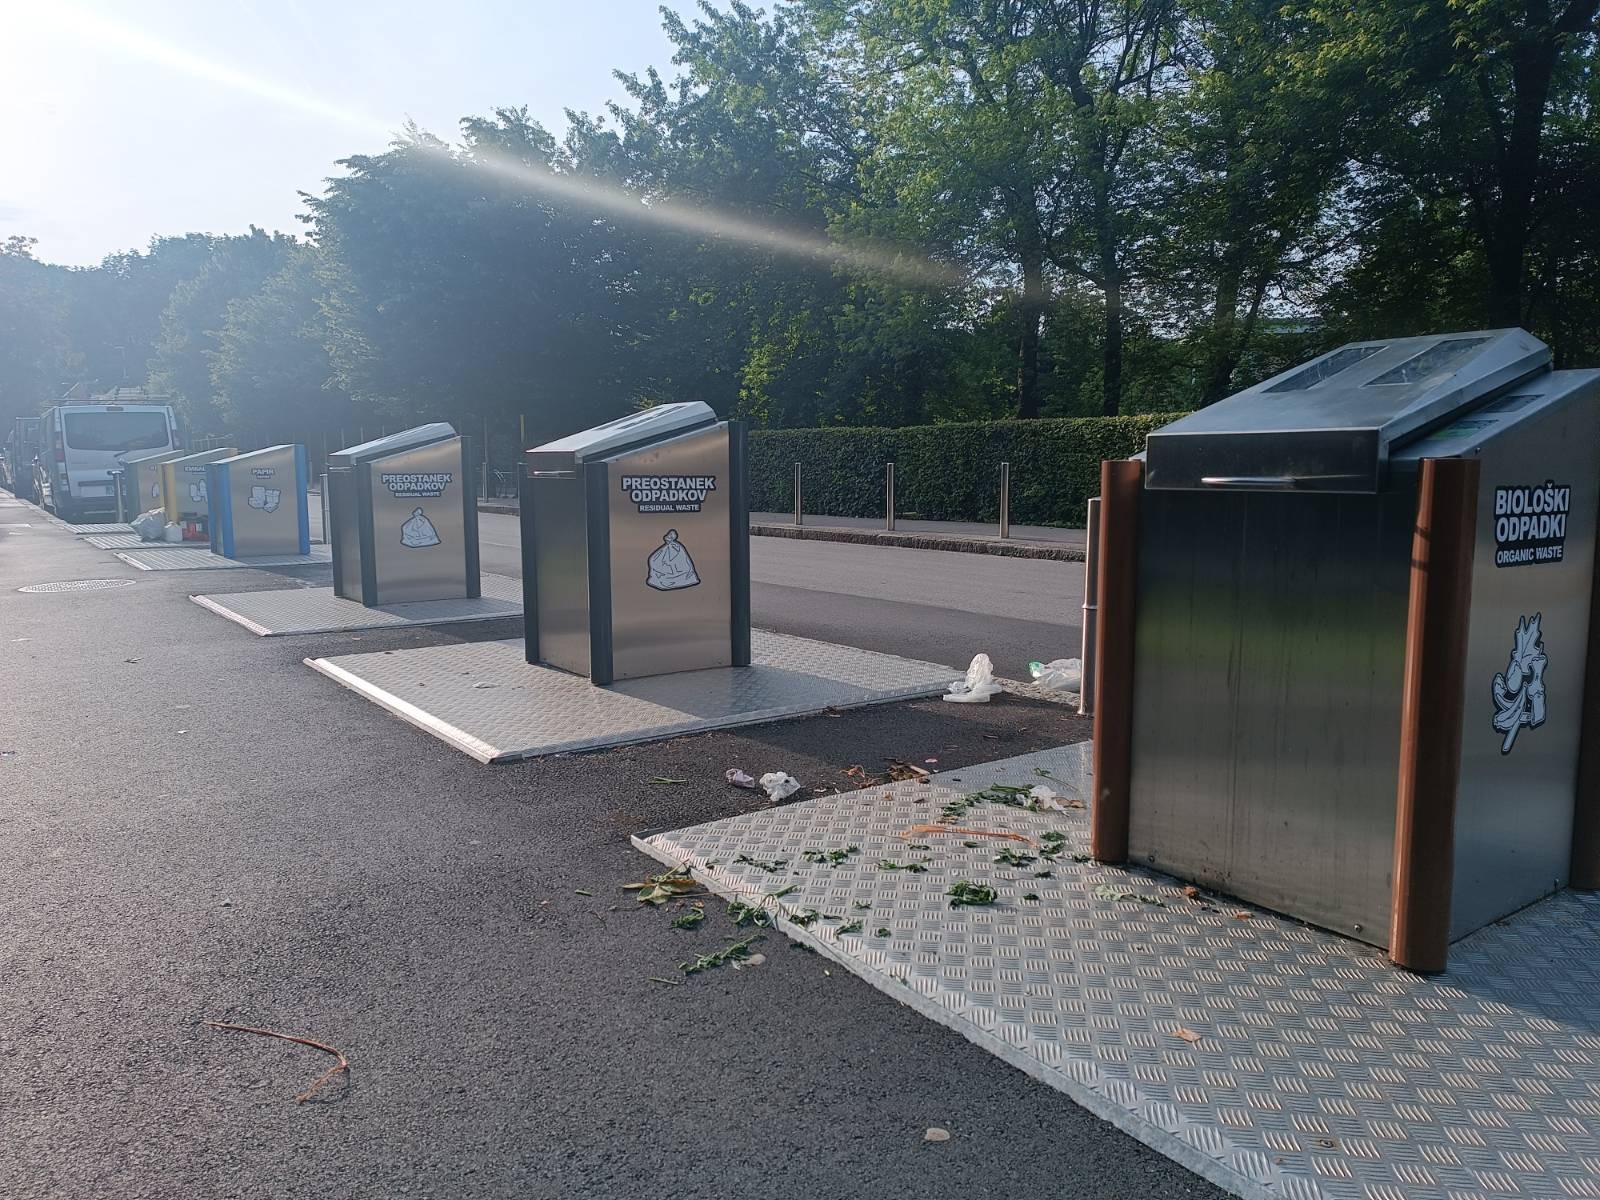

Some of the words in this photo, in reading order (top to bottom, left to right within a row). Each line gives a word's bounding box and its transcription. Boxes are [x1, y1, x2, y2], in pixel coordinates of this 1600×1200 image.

[382, 474, 452, 483] PREOSTANEK
[622, 477, 715, 490] PREOSTANEK
[389, 482, 445, 491] ODPADKOV
[631, 489, 707, 502] ODPADKOV
[1495, 482, 1570, 515] BIOLOŠKI
[639, 504, 675, 512] RESIDUAL
[1496, 513, 1567, 542] ODPADKI
[1497, 547, 1535, 564] ORGANIC
[1535, 545, 1563, 560] WASTE
